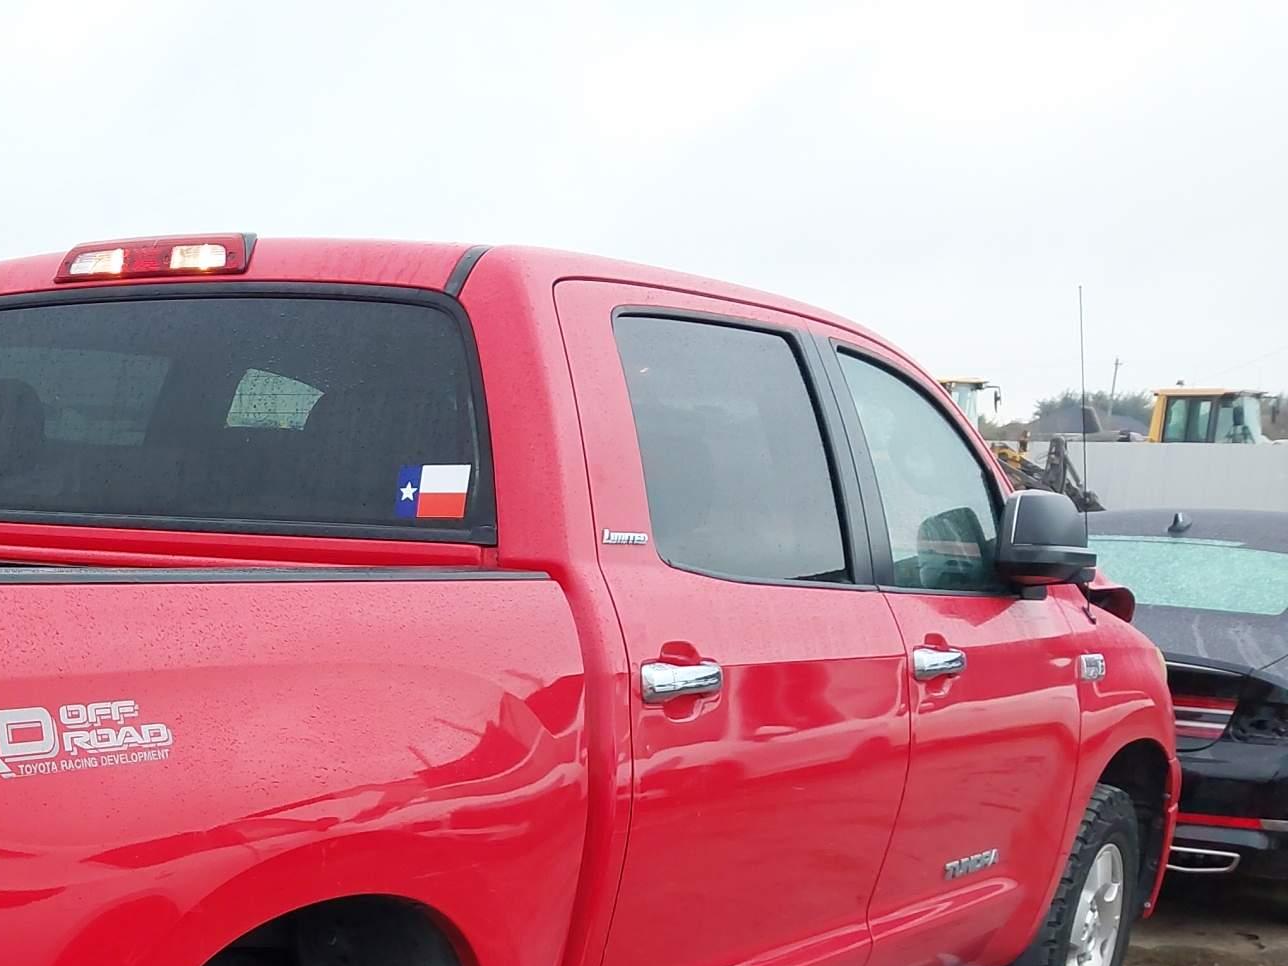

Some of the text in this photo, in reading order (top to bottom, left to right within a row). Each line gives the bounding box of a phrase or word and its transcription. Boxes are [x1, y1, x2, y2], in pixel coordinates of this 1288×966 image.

[58, 700, 140, 729] OFF
[62, 722, 174, 757] ROAD
[17, 748, 171, 776] TOYOTA RACING DEVELOPMENT
